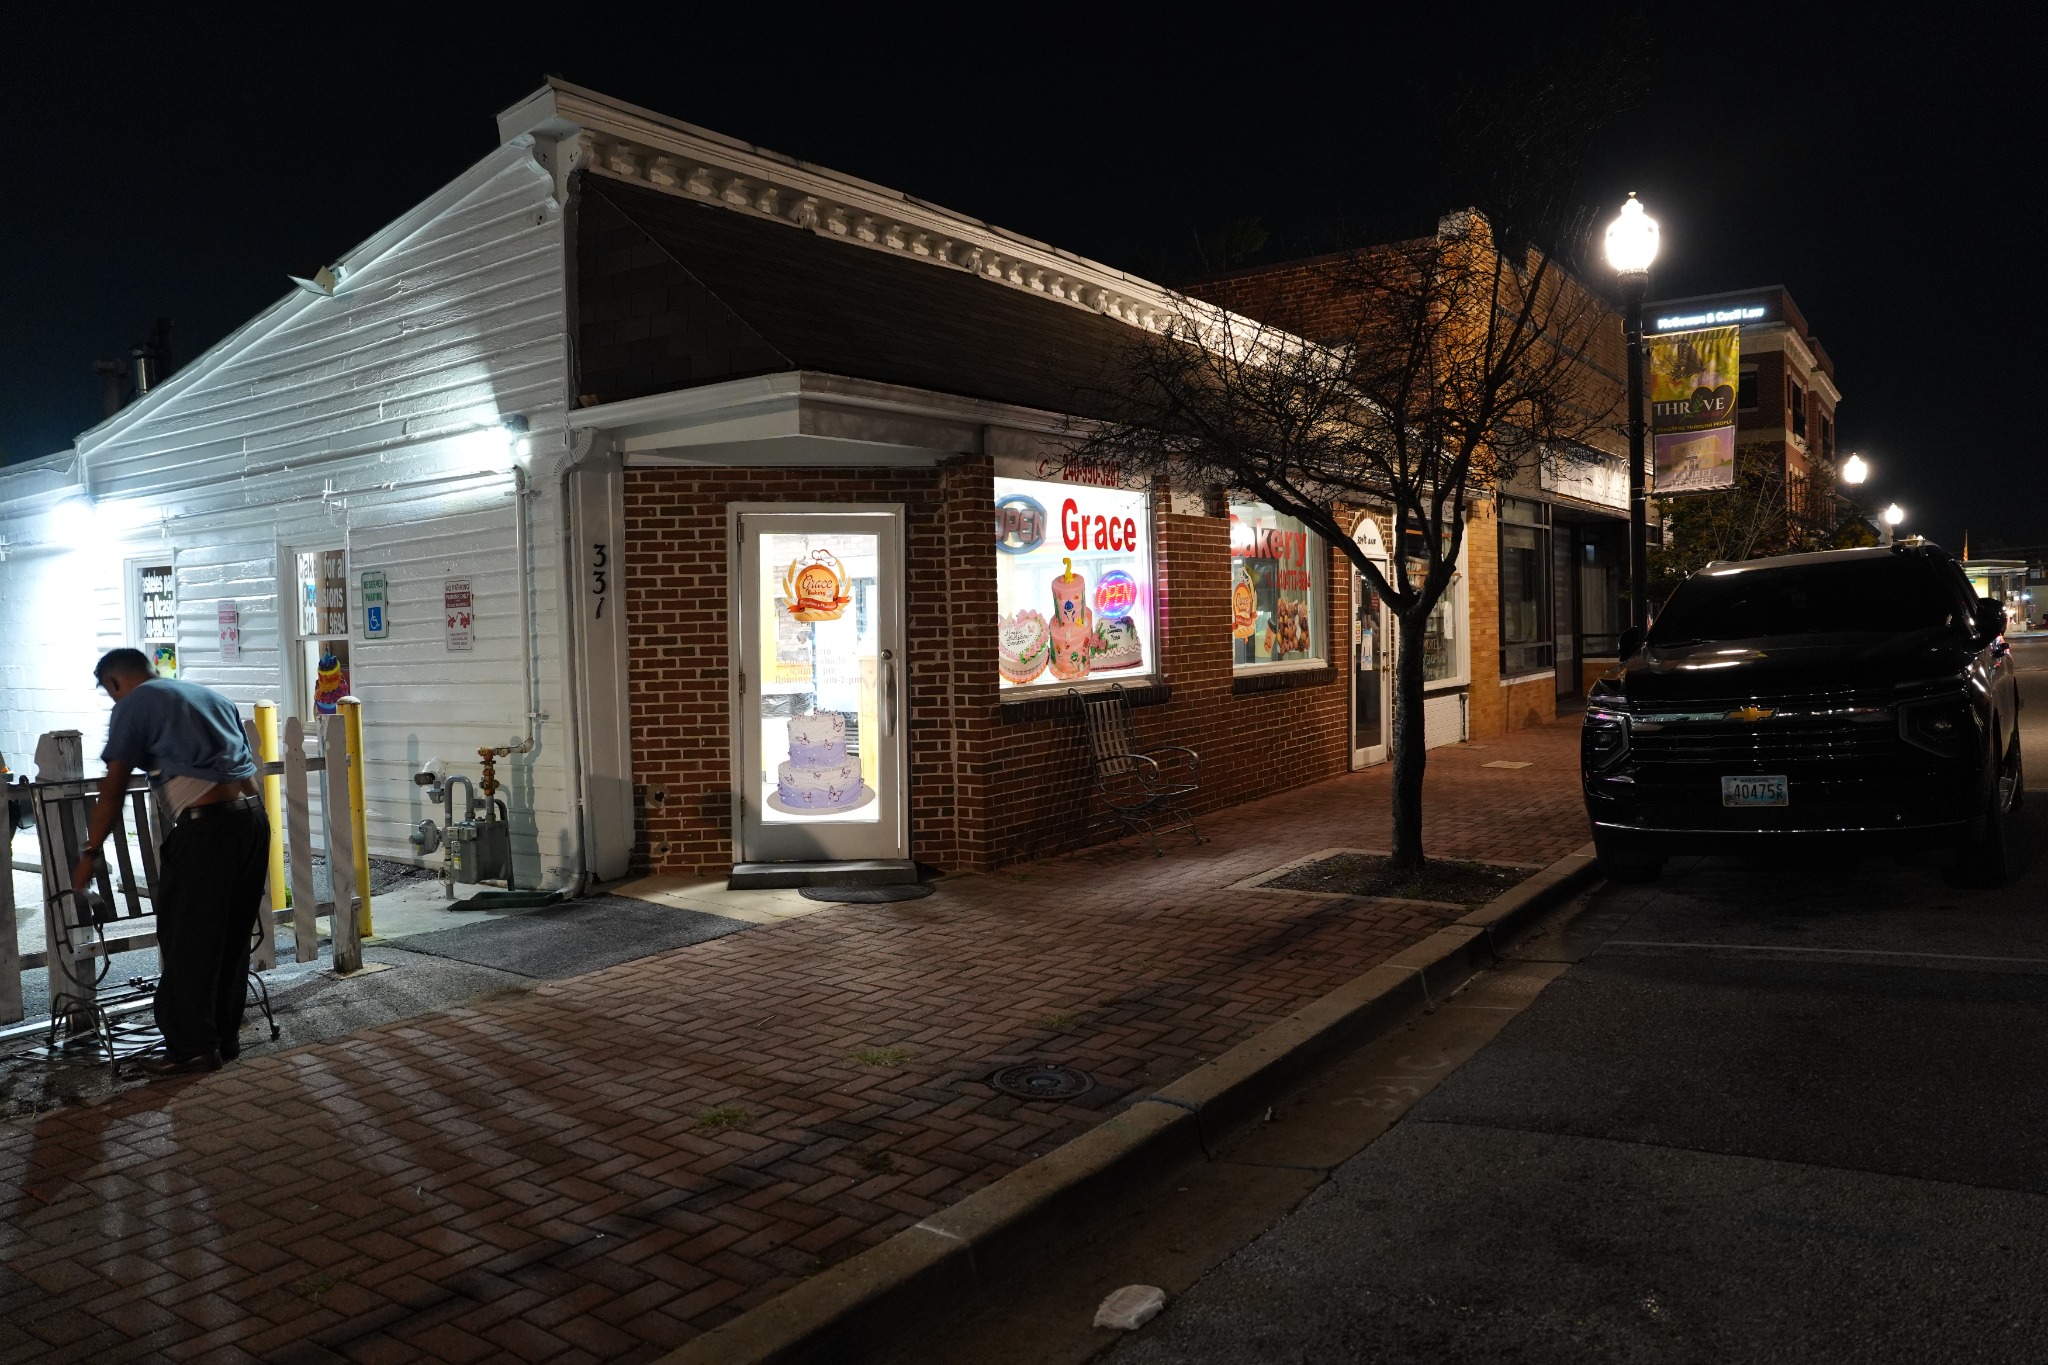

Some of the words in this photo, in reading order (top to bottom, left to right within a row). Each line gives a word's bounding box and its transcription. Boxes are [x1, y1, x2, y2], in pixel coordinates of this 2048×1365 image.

[1706, 312, 1715, 323] &
[1742, 307, 1764, 319] Law
[1686, 422, 1713, 431] THROUGH
[1713, 419, 1733, 427] PEOPLE
[1671, 475, 1718, 488] DENTIST
[1673, 468, 1714, 480] LAUREL
[995, 507, 1047, 544] OPEN
[1062, 498, 1136, 552] Grace
[1230, 514, 1307, 567] Bakery
[324, 552, 335, 579] for
[363, 579, 384, 590] RESERVED
[452, 583, 470, 592] PARKING
[592, 543, 607, 620] 331
[802, 574, 832, 592] Grace
[365, 592, 383, 602] PARKING
[1097, 583, 1134, 611] OPEN
